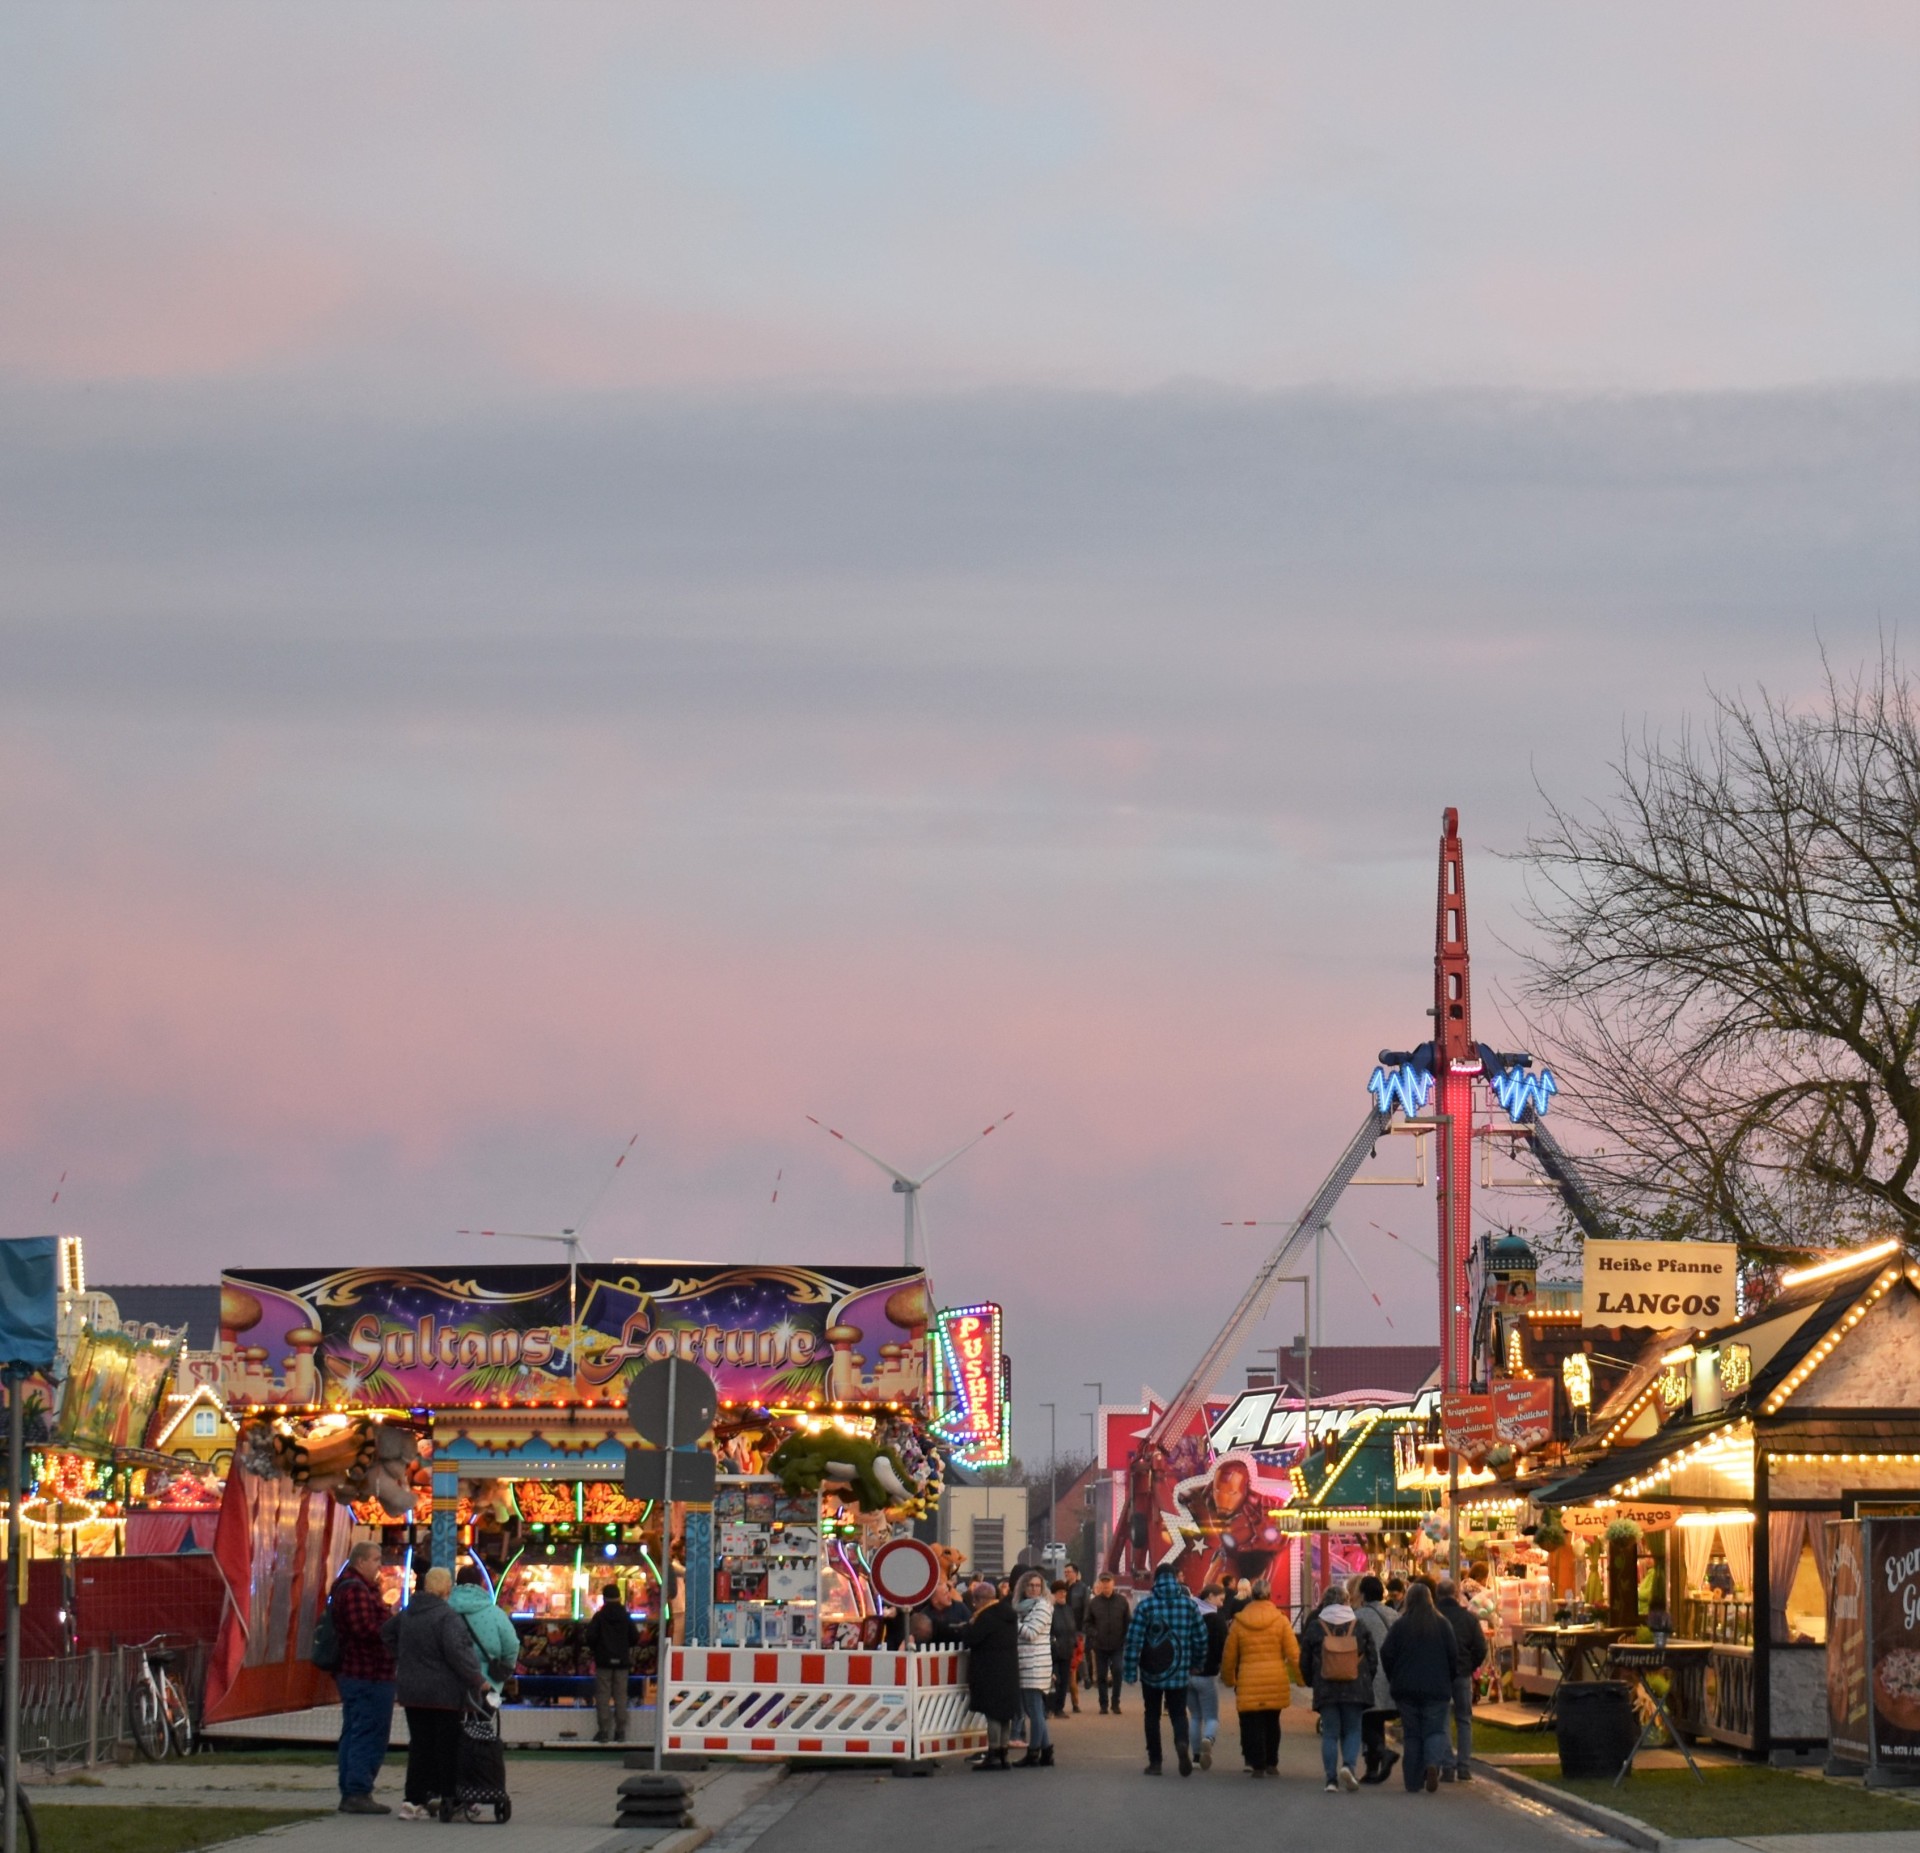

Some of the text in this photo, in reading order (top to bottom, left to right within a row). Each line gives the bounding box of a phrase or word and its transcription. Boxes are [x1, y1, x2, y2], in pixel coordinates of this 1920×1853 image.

[1599, 1257, 1723, 1274] Heiße Pfanne
[1596, 1292, 1721, 1317] LANGOS
[325, 1310, 816, 1384] Sultans Fortune
[959, 1317, 991, 1431] PUSHER
